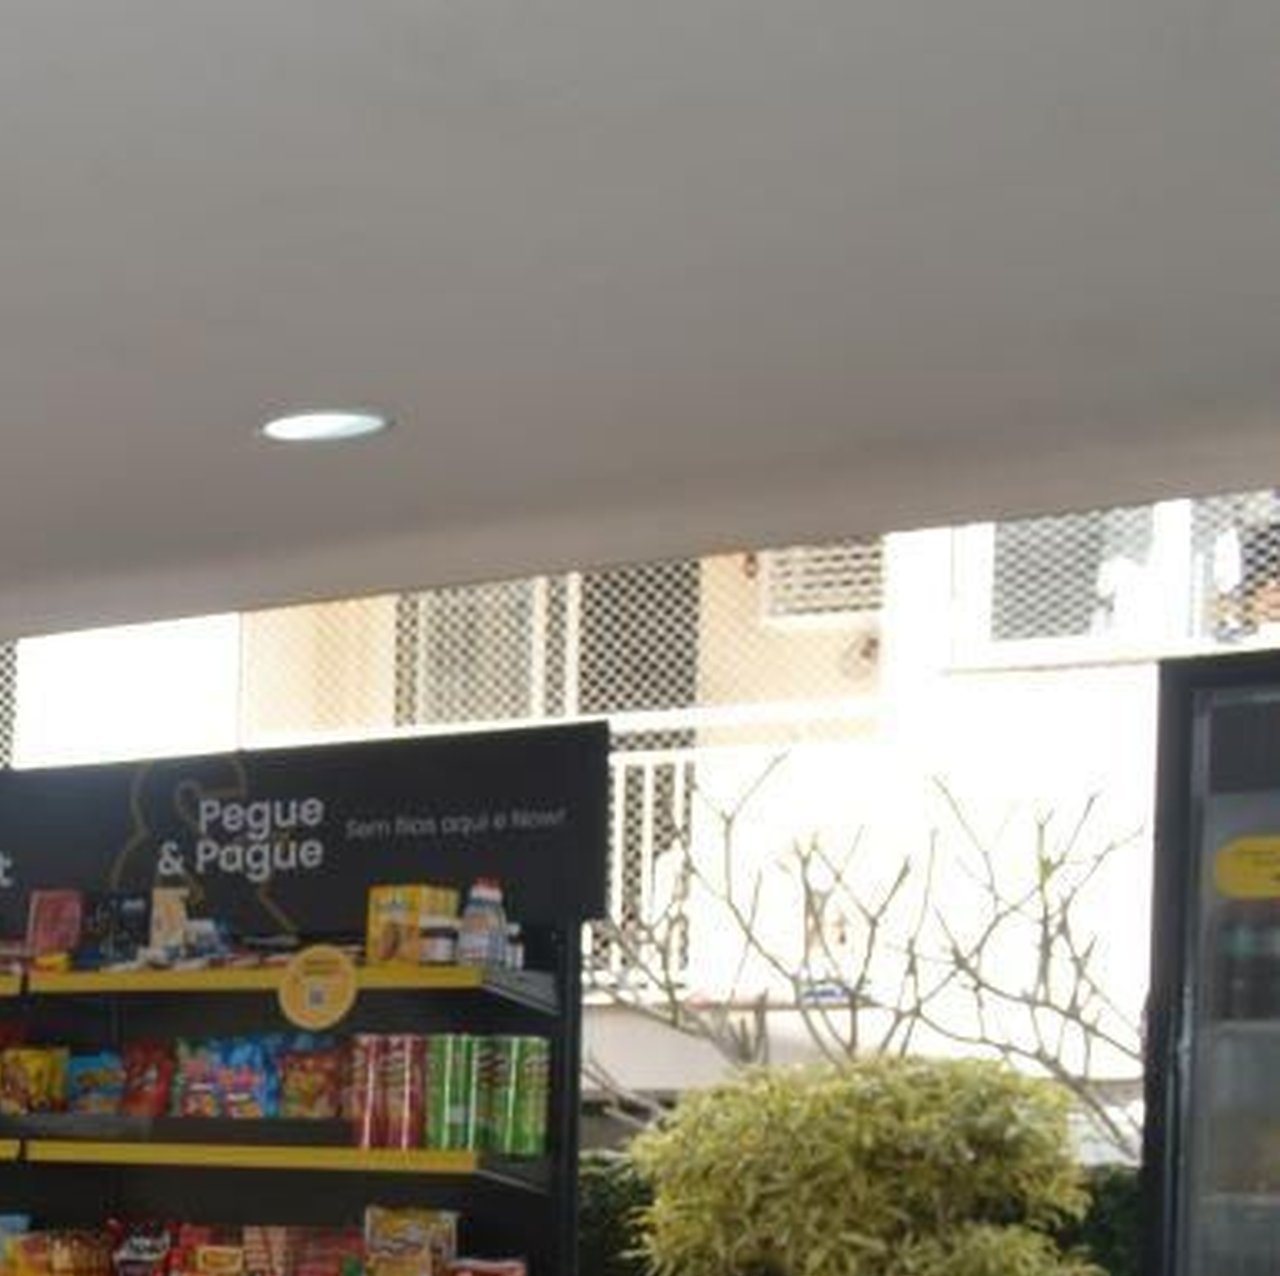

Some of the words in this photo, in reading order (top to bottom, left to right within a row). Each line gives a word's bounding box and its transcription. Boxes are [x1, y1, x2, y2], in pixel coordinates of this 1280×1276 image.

[197, 799, 325, 840] Pegue
[157, 840, 184, 876] &
[196, 838, 325, 882] Pague
